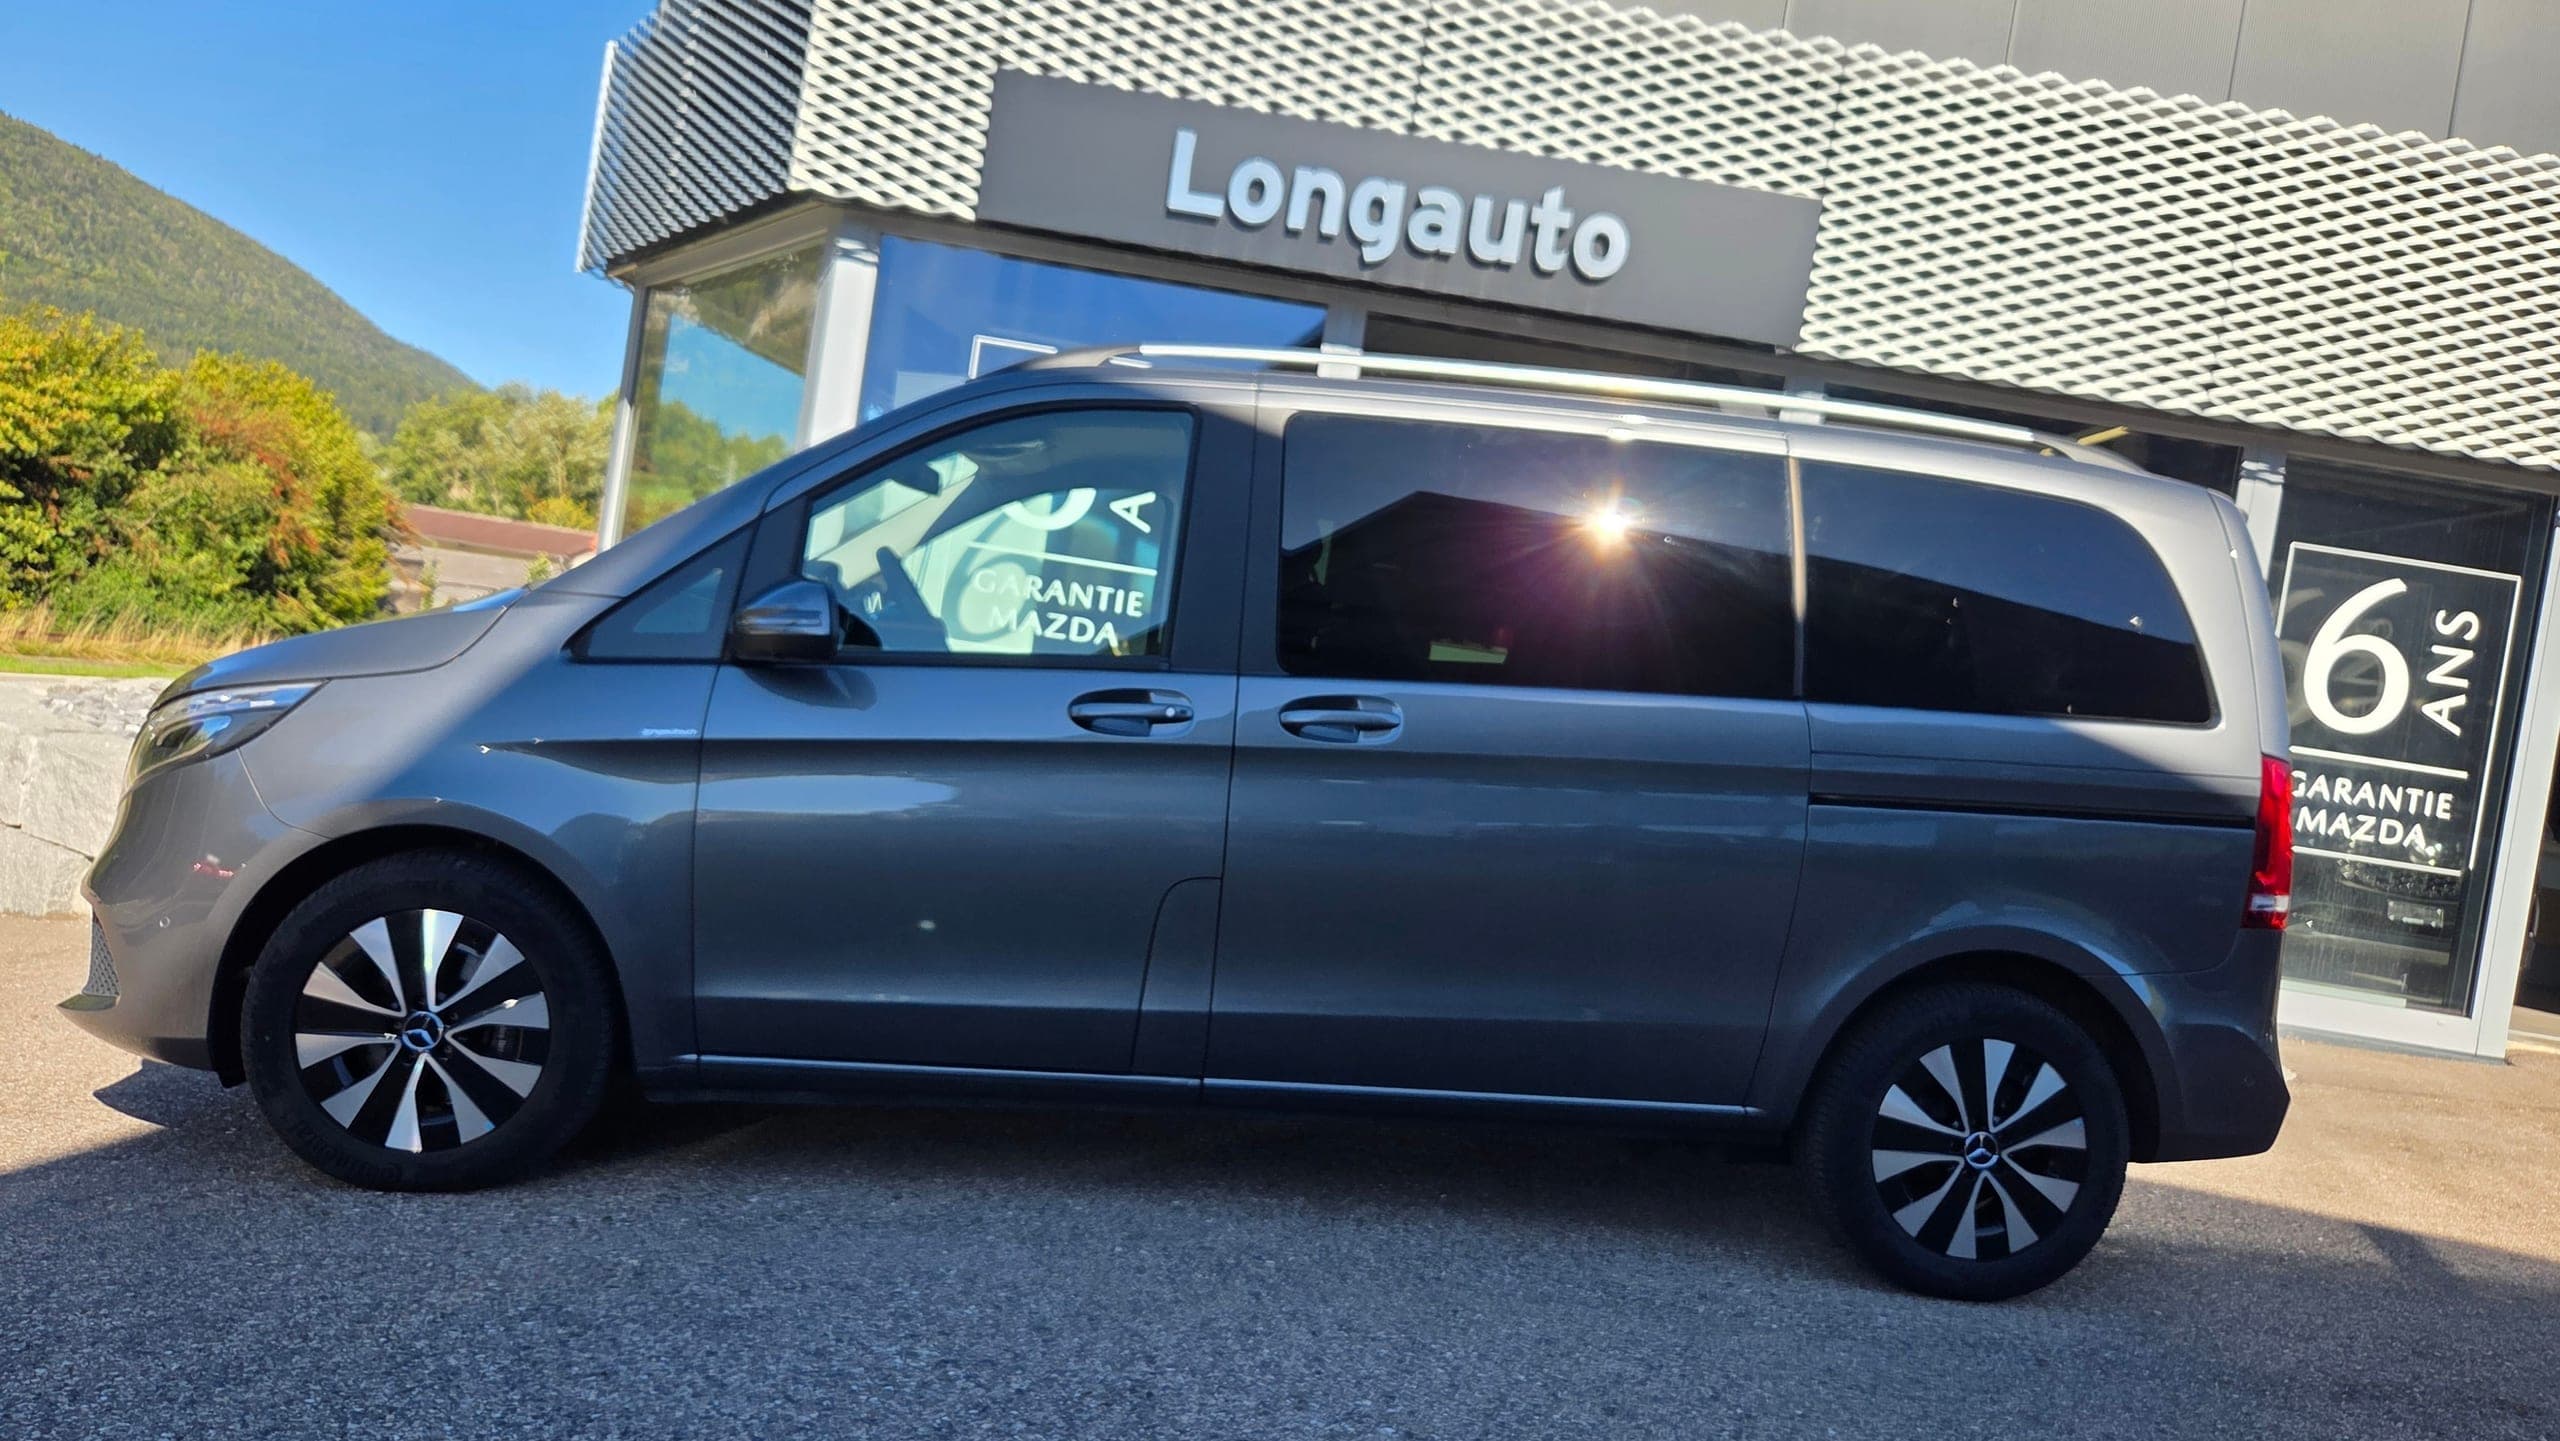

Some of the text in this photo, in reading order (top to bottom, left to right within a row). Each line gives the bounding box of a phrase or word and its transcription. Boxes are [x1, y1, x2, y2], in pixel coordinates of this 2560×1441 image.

[1165, 127, 1631, 280] Longauto
[974, 568, 1145, 618] GARANTIE
[989, 605, 1122, 657] MAZDA
[2303, 577, 2410, 735] 6
[2420, 608, 2480, 737] ANS
[2295, 805, 2427, 851] MAZDA
